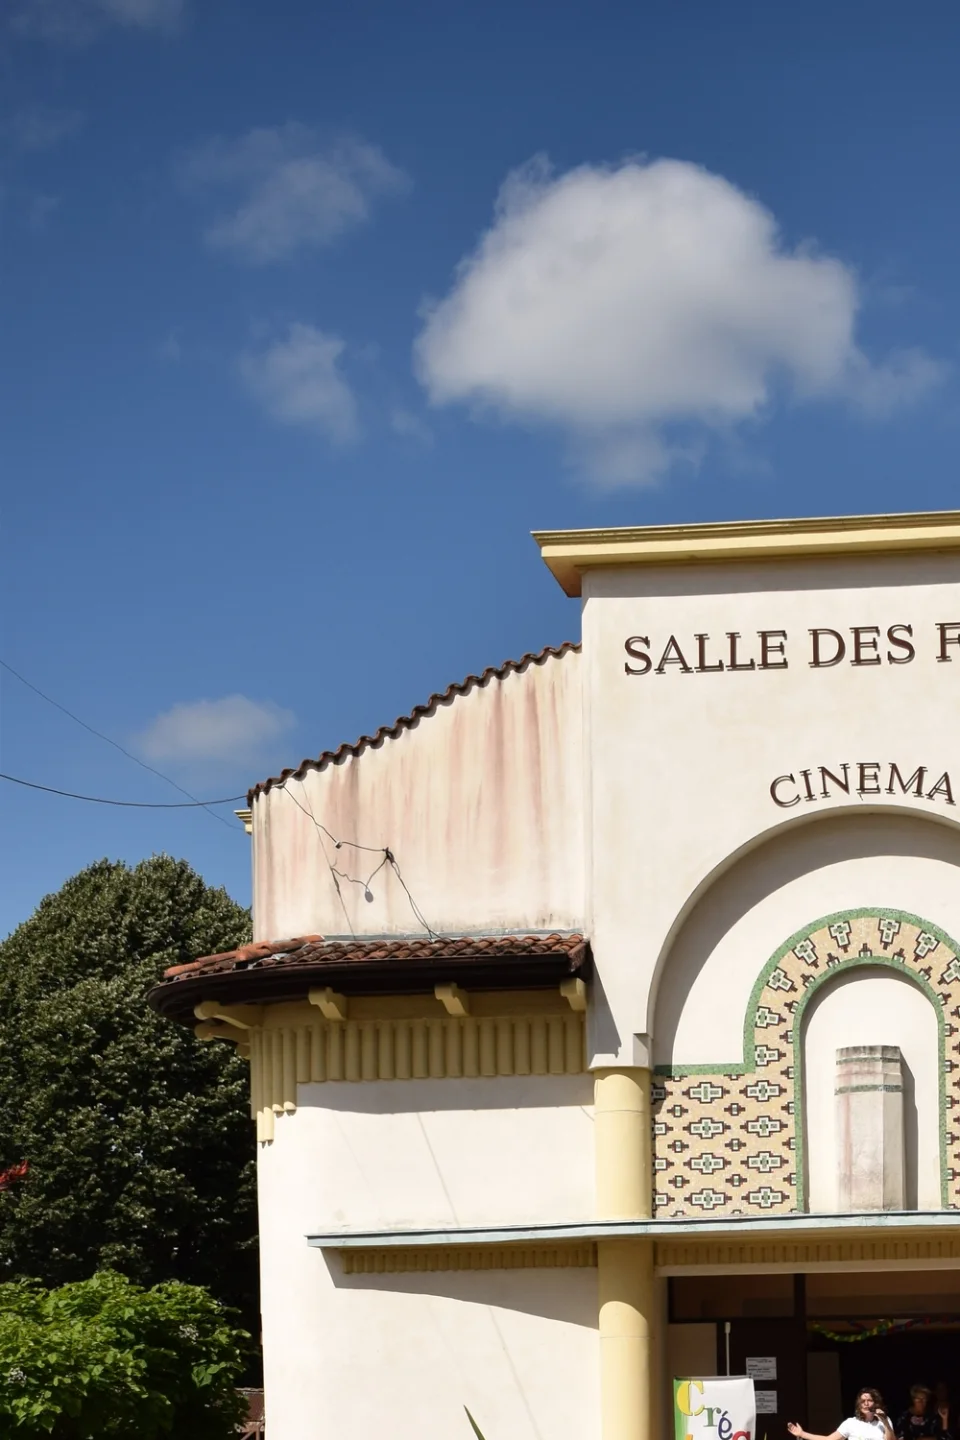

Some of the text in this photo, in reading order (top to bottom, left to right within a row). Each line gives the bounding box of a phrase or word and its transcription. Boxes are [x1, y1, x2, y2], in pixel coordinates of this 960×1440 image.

[624, 630, 788, 675] SALLE
[808, 624, 915, 668] DES
[769, 762, 957, 807] CINEMA
